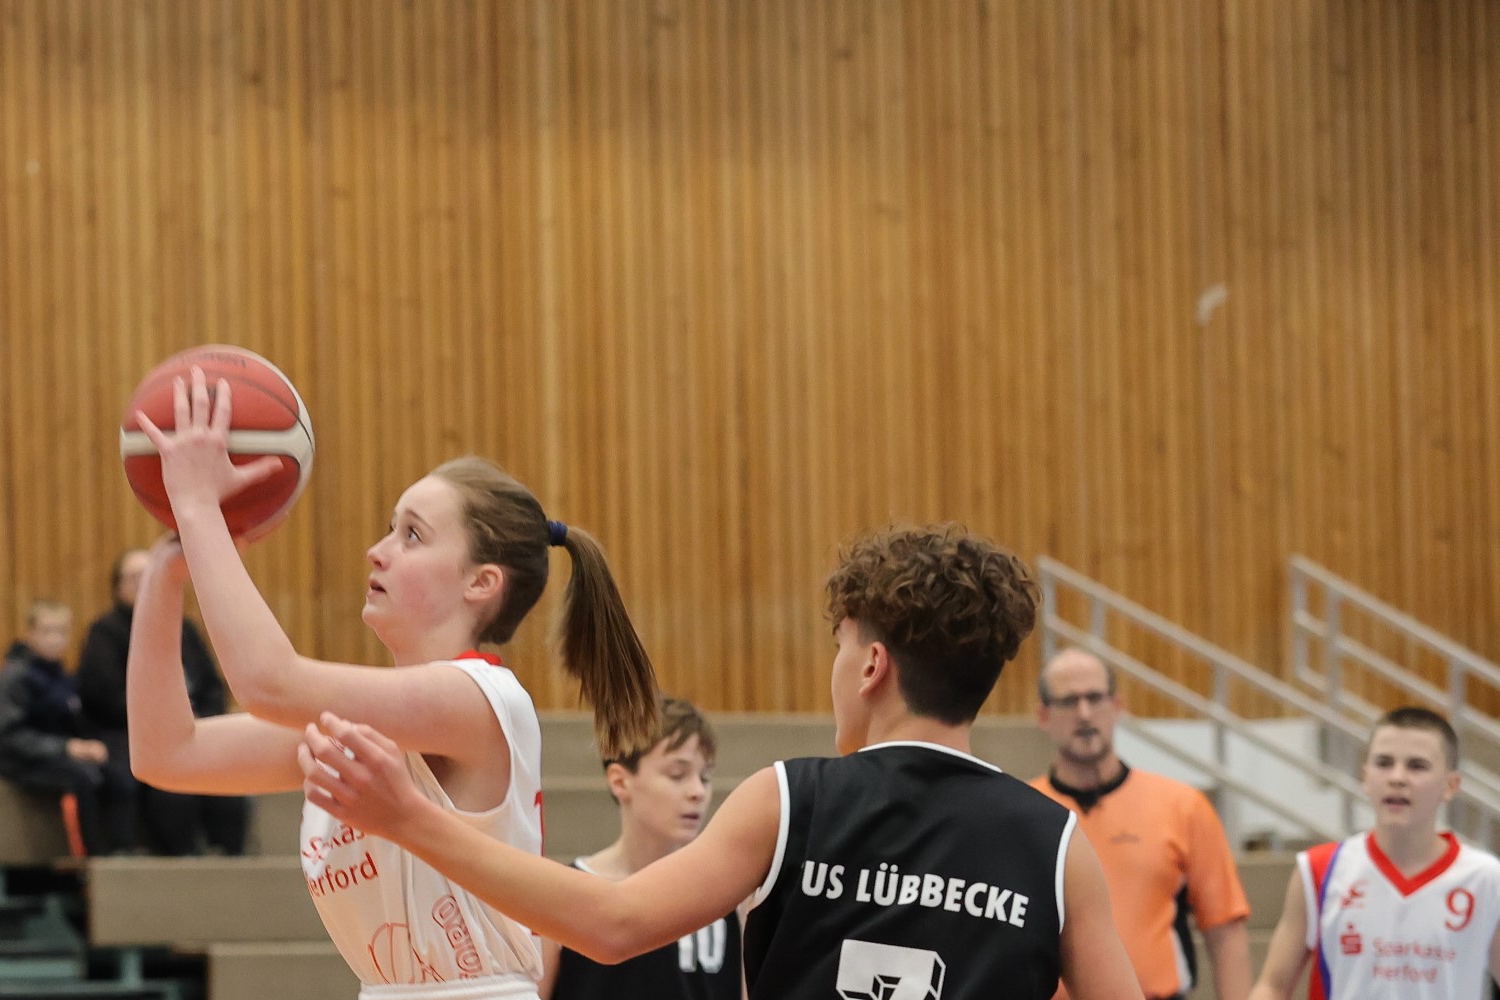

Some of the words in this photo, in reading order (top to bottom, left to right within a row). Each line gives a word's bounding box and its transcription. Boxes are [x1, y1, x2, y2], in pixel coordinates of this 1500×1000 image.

[303, 850, 379, 897] erford
[801, 860, 845, 899] US
[855, 862, 1030, 928] LÜBBECKE
[1445, 887, 1476, 932] 9
[677, 917, 727, 974] 10
